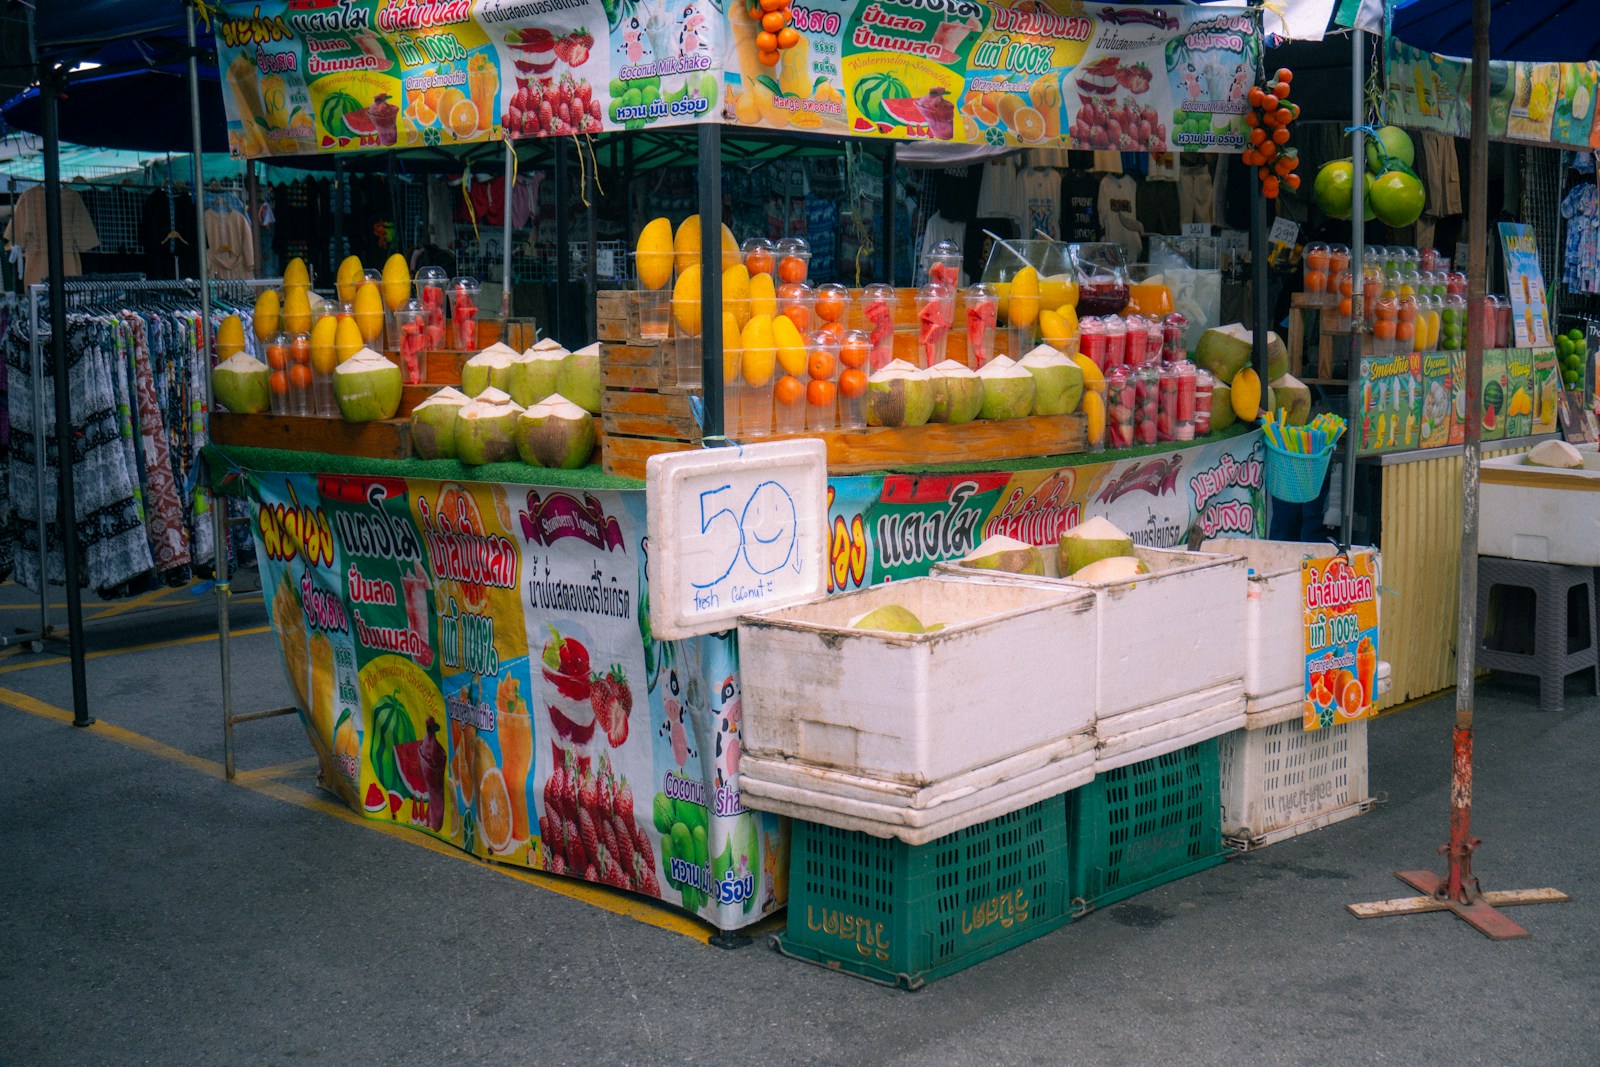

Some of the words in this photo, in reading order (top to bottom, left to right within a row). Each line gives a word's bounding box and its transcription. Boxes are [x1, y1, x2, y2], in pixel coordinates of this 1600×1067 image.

[292, 0, 370, 34] แตงโม
[861, 5, 927, 33] ปั่นสด
[307, 34, 352, 54] ปั่นสด
[396, 34, 422, 66] แท้
[418, 33, 468, 63] 100%
[852, 25, 943, 58] ปั่นนมสด
[974, 36, 1009, 68] แท้
[1006, 42, 1054, 75] 100%
[1185, 33, 1244, 53] นมสด
[308, 54, 379, 76] ปั่นนมสด
[405, 75, 432, 91] Orange
[432, 69, 467, 87] Smoothie
[620, 63, 657, 81] Coconut
[657, 57, 678, 75] Milk
[678, 53, 712, 72] Shake
[847, 54, 910, 73] Watermelon
[911, 60, 952, 88] Smoothie
[616, 105, 647, 120] หวาน
[650, 99, 669, 117] มัน
[671, 95, 708, 115] อร่อย
[772, 95, 800, 113] Mango
[801, 97, 842, 115] Smoothie
[1182, 100, 1211, 113] Coconut
[1178, 132, 1201, 145] หวาน
[1274, 227, 1295, 242] 299
[1370, 355, 1409, 381] Smoothie
[336, 484, 421, 563] แตงโม
[541, 508, 576, 536] Strawberry
[571, 509, 601, 540] Yogurt
[691, 480, 797, 589] 50
[876, 481, 979, 568] แตงโม
[349, 562, 397, 606] ปั่นสด
[694, 589, 720, 611] fresh
[1306, 562, 1373, 611] น้ำส้มปั่นสด
[354, 610, 423, 657] ปั่นนมสด
[441, 596, 460, 668] แท้
[460, 613, 499, 678] 100%
[1309, 613, 1327, 651] แท้
[1328, 613, 1360, 647] 100%
[1308, 656, 1332, 675] Orange
[1329, 651, 1356, 671] Smoothie
[363, 659, 405, 694] Watermelon
[406, 658, 440, 716] Smoothie
[671, 857, 701, 890] หวาน
[961, 887, 1030, 935] วินิสดา
[806, 904, 890, 961] วินิสดา
